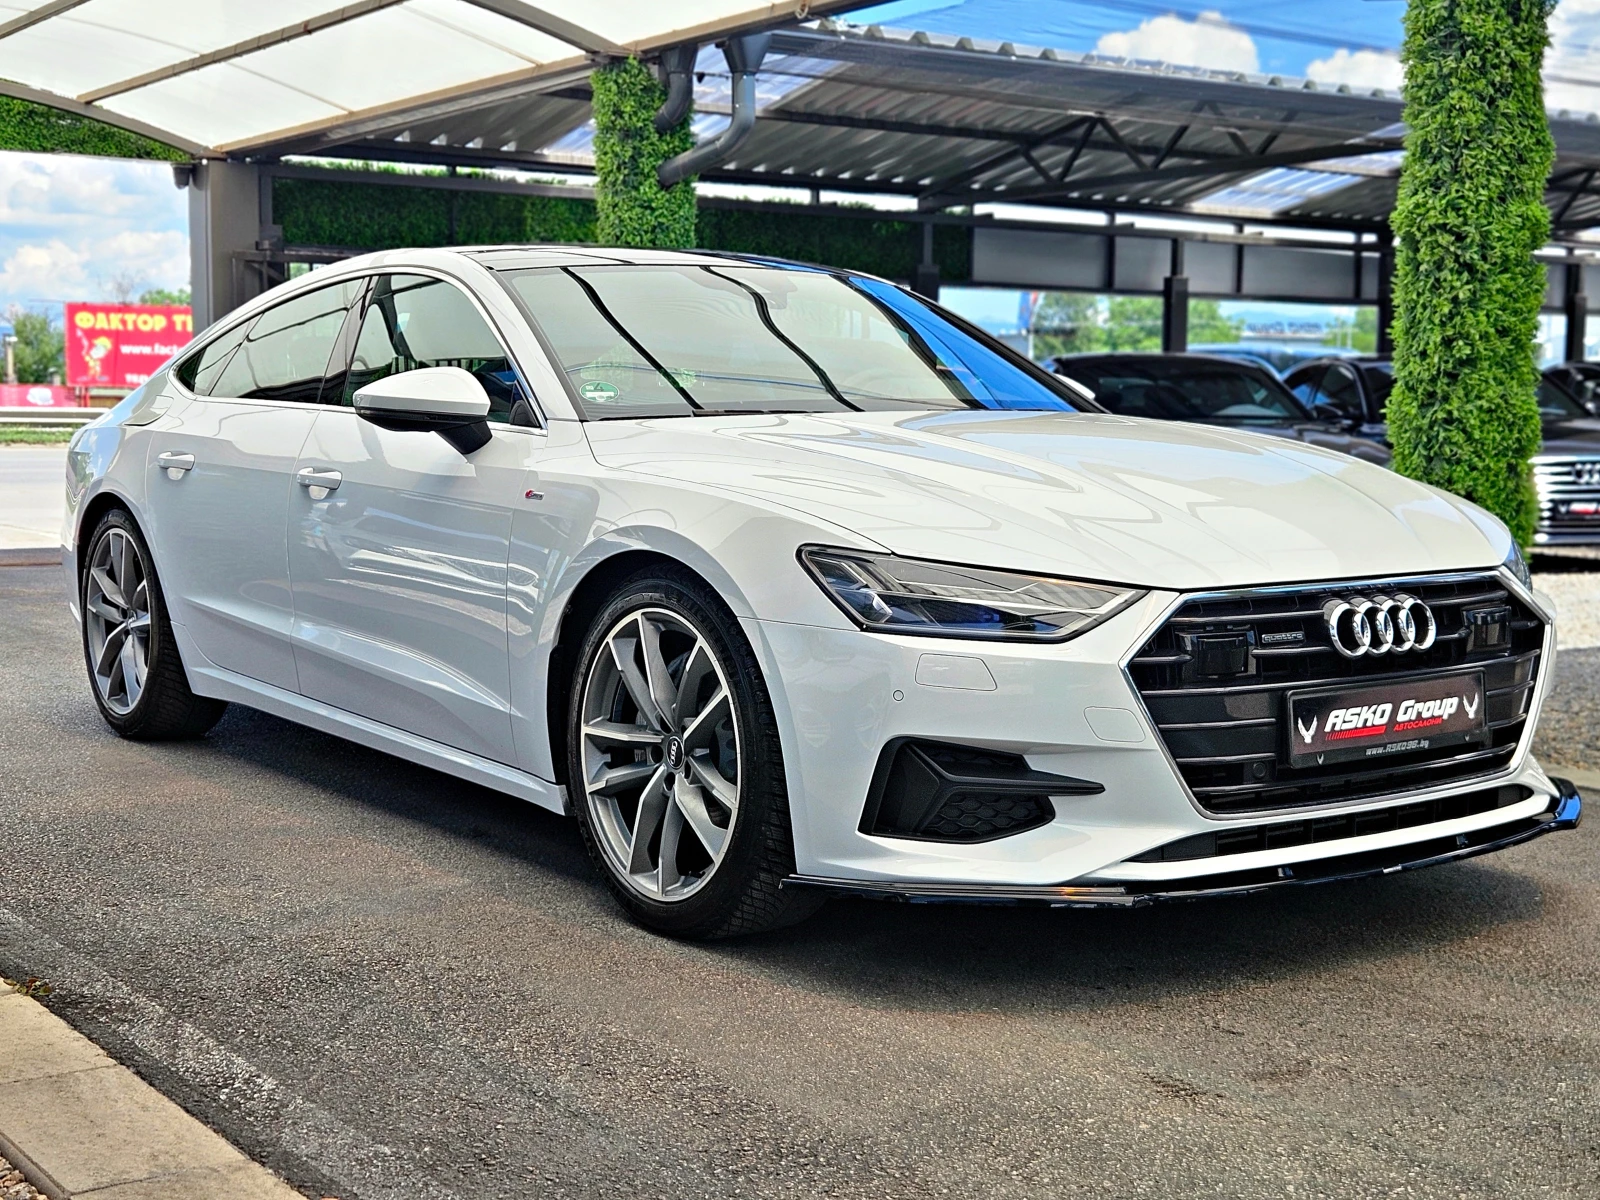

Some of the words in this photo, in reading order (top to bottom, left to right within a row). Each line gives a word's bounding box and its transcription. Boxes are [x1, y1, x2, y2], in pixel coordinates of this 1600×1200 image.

[74, 311, 167, 331] ФАКТОР
[1264, 633, 1303, 643] quattro
[1324, 703, 1393, 732] ASKO
[1396, 696, 1459, 722] Group
[1393, 717, 1443, 731] АВТОСАЛОНИ
